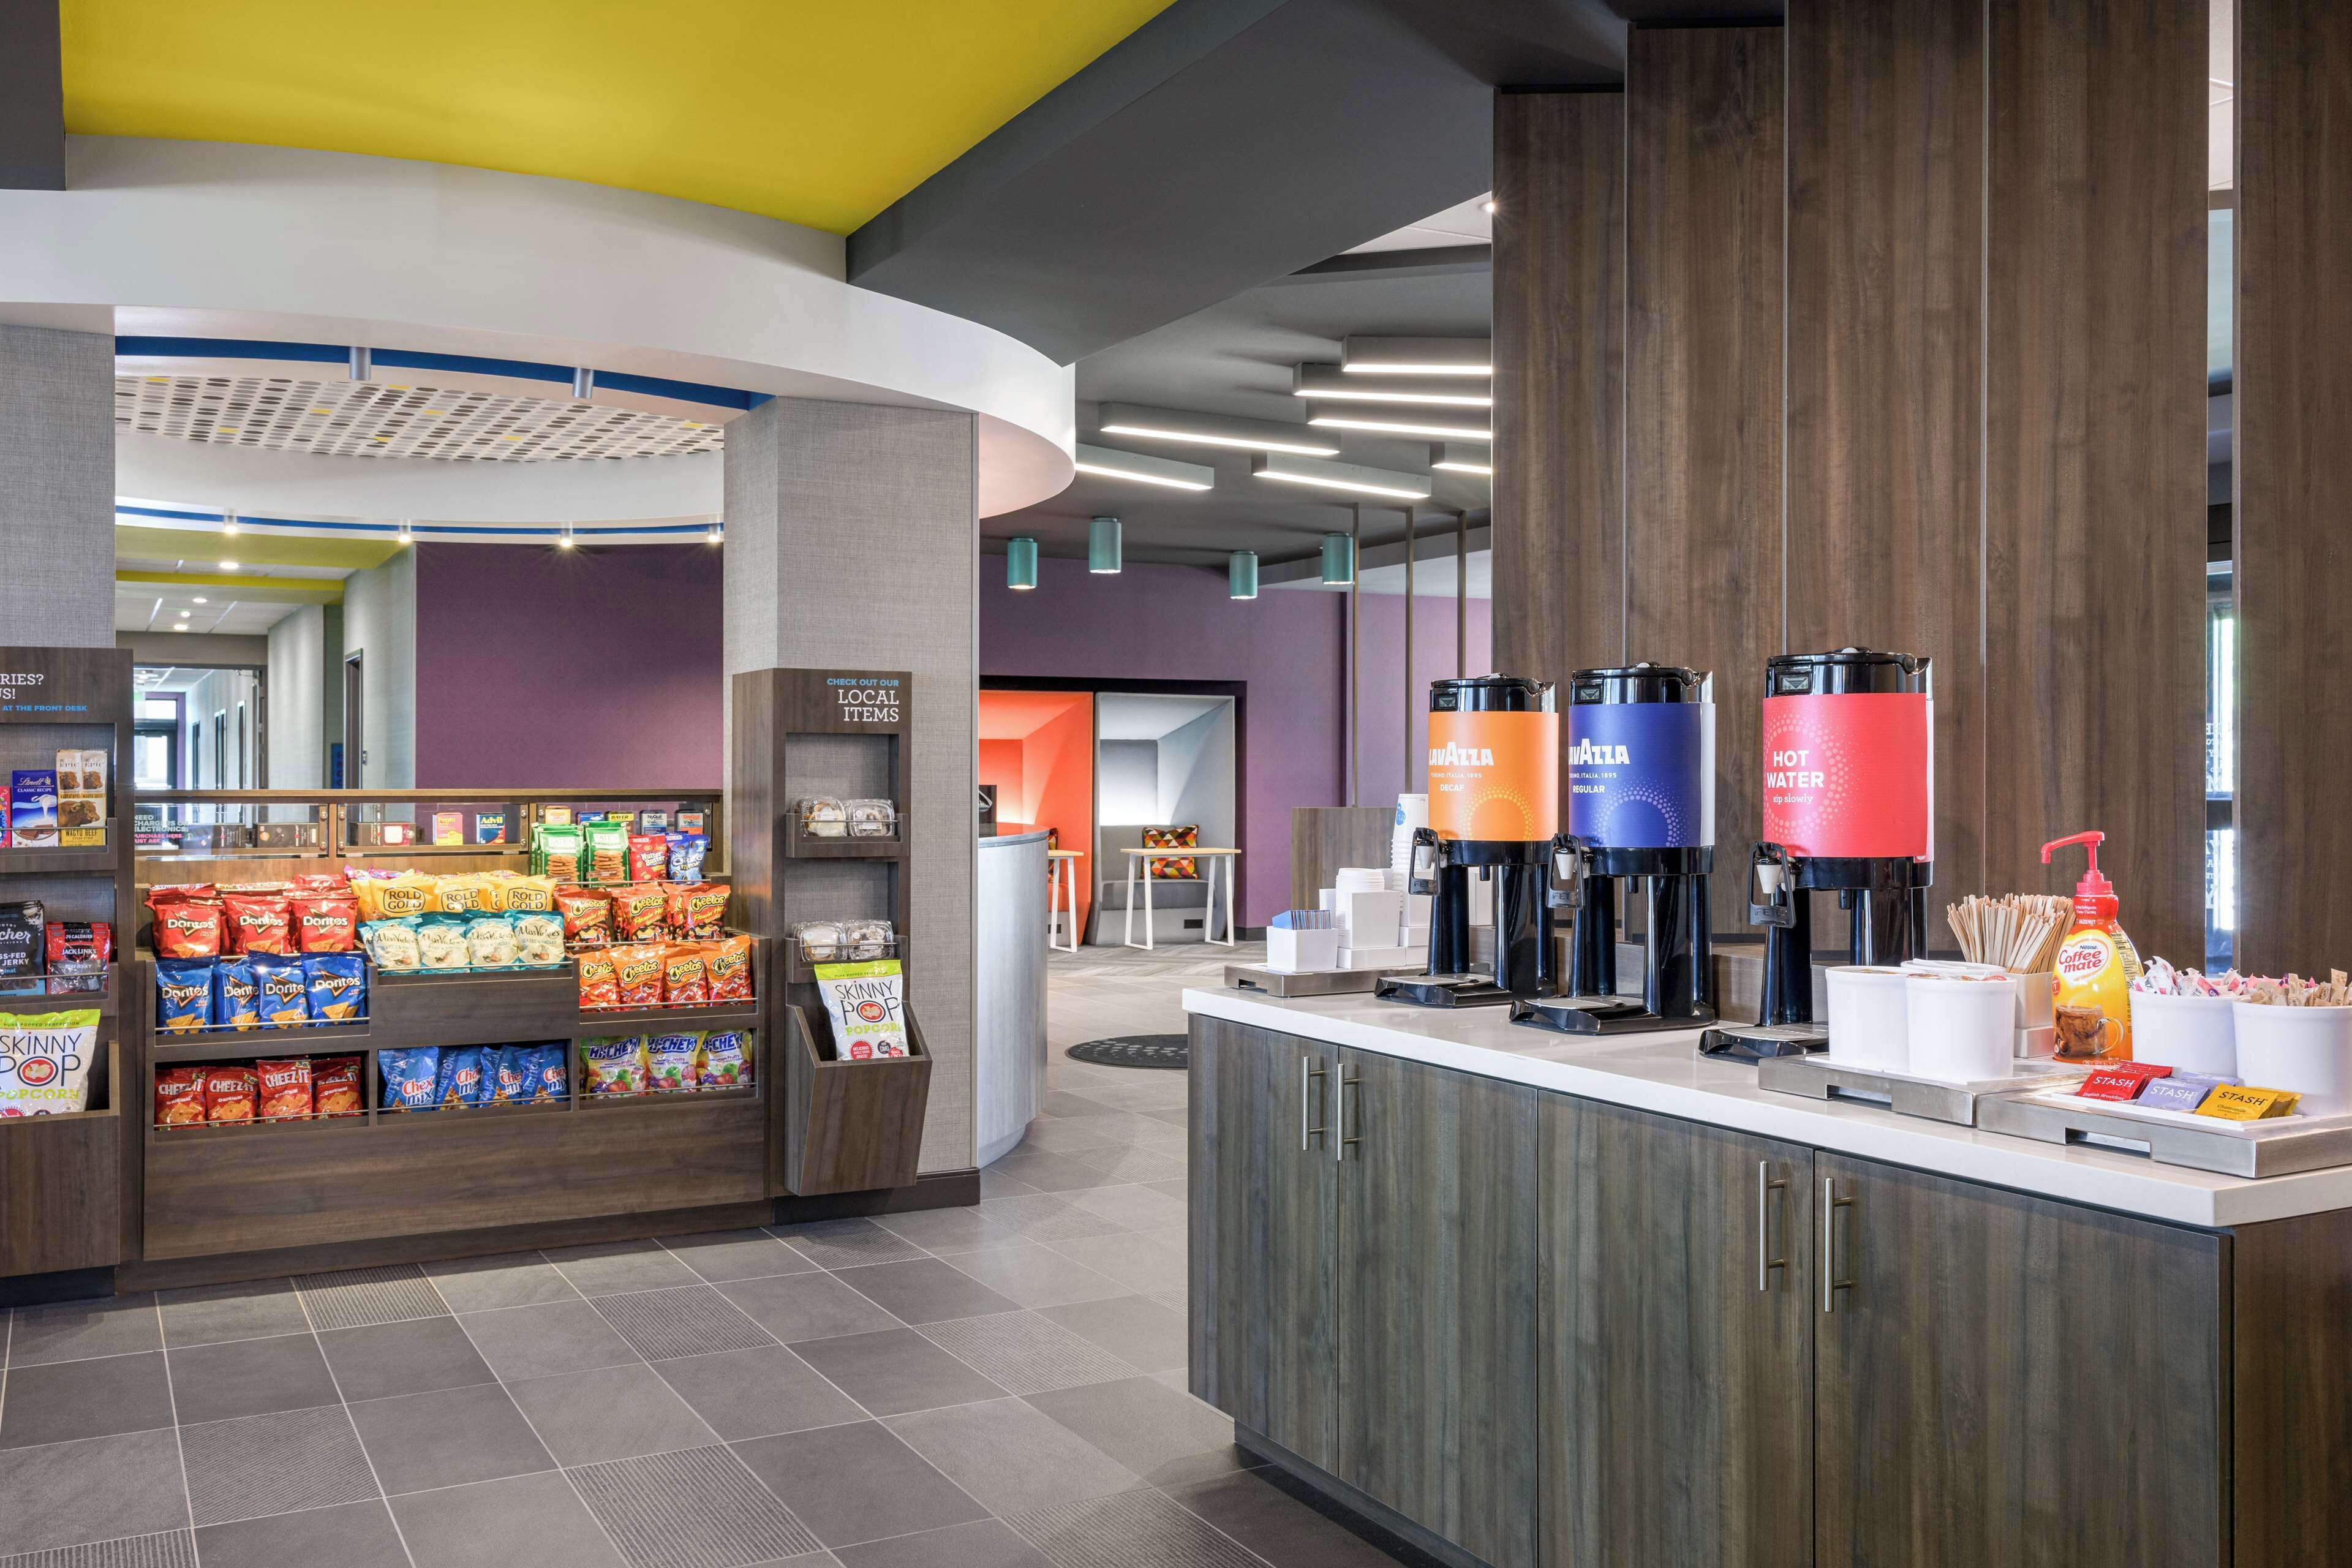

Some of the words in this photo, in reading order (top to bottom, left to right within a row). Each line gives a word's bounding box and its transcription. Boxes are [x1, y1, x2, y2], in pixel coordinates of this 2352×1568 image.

[838, 689, 899, 704] LOCAL
[843, 707, 899, 722] ITEMS
[1569, 738, 1630, 764] AVAZZA
[1773, 750, 1809, 767] HOT
[18, 777, 43, 785] Lindt
[1766, 771, 1825, 788] WATER
[1773, 794, 1783, 804] sip
[1784, 794, 1813, 805] slowly
[641, 852, 663, 861] Nutter
[646, 856, 665, 865] Butter
[390, 891, 421, 900] ROLD
[447, 891, 478, 902] ROLD
[513, 891, 543, 901] ROLD
[388, 900, 421, 910] GOLD
[447, 900, 479, 910] GOLD
[571, 900, 608, 917] Cheetos
[630, 896, 665, 916] Cheetos
[690, 894, 725, 913] Cheetos
[167, 919, 214, 929] Doritos
[239, 916, 285, 926] Doritos
[303, 916, 348, 926] Doritos
[713, 951, 747, 975] Cheetos
[2059, 949, 2101, 965] Coffee
[622, 960, 659, 982] Cheetos
[668, 960, 703, 981] Cheetos
[2064, 959, 2101, 973] mate
[265, 983, 304, 995] Dorito
[315, 977, 361, 989] Doritos
[162, 986, 209, 999] Doritos
[224, 985, 259, 998] Dorito
[840, 997, 900, 1025] POP
[589, 1036, 640, 1059] HI-CHEW
[647, 1036, 698, 1053] HI-CHEW
[265, 1069, 309, 1088] CHEEZ-IT
[402, 1076, 434, 1095] Chex
[2093, 1076, 2135, 1088] STASH
[158, 1079, 203, 1095] CHEEZ-IT
[209, 1080, 254, 1092] CHEEZ-IT
[2150, 1086, 2195, 1099] STASH
[407, 1090, 433, 1106] mix
[2218, 1091, 2266, 1106] STASH
[2217, 1104, 2247, 1113] Chamomile
